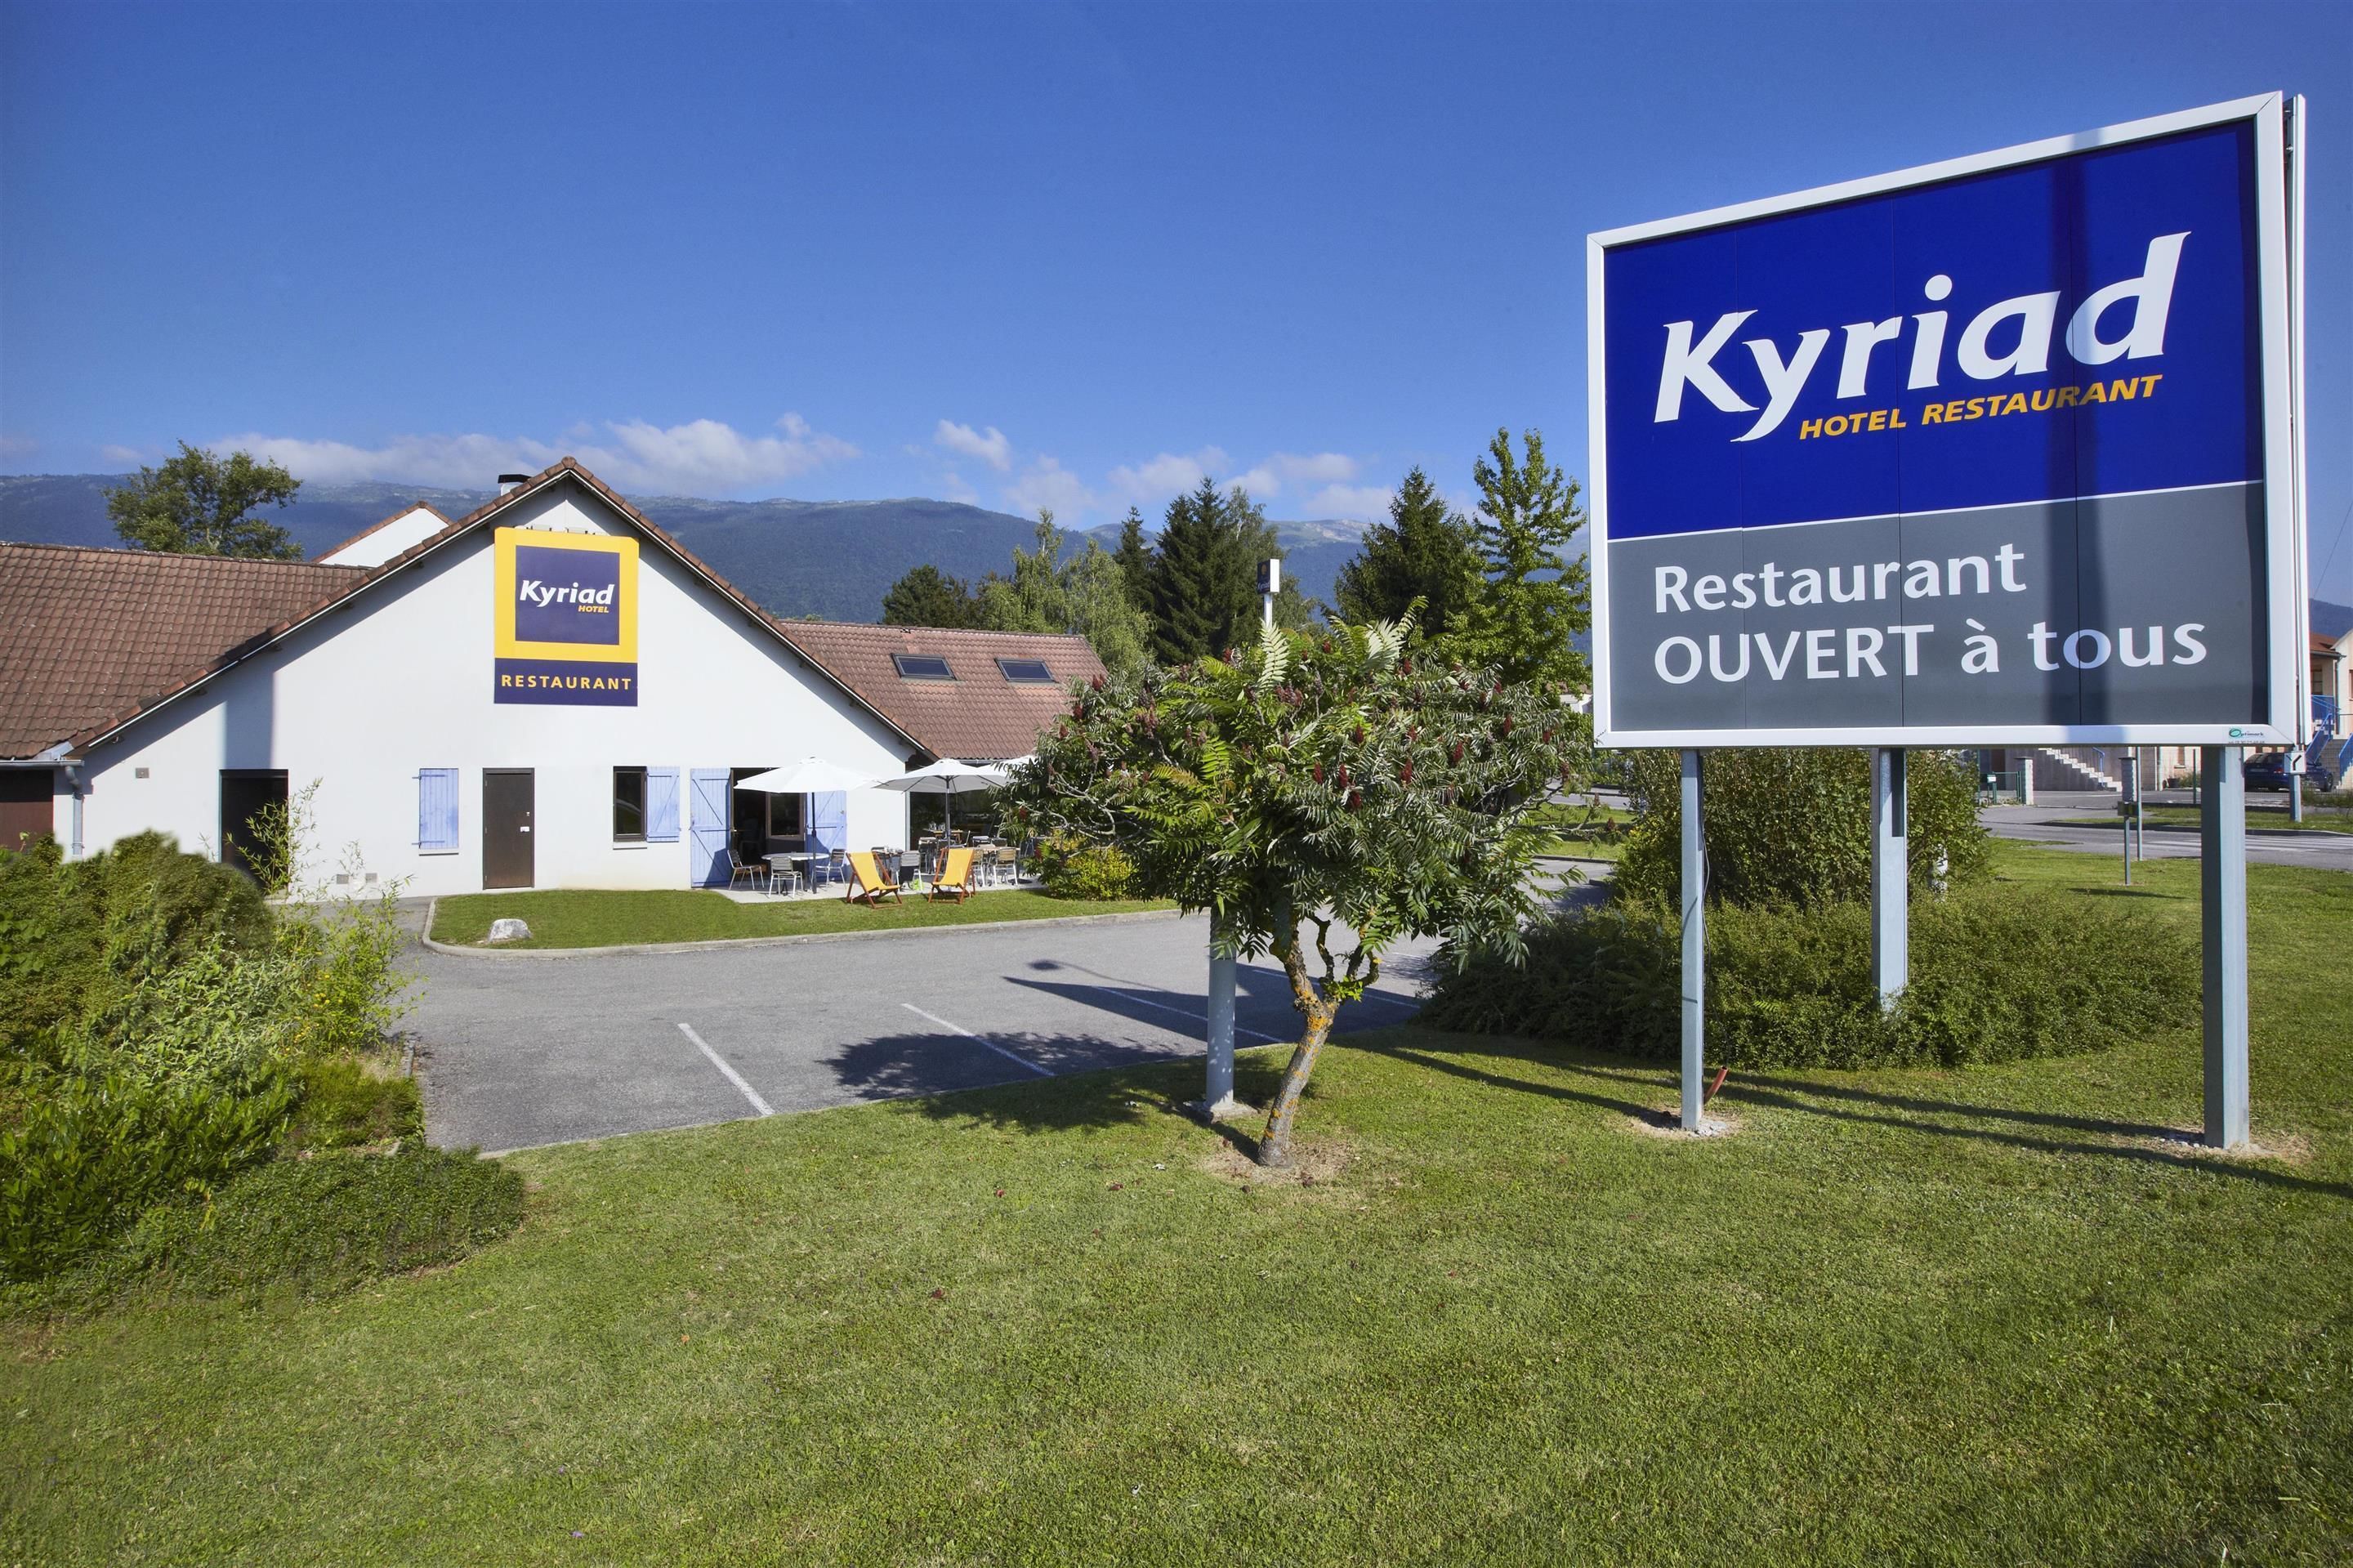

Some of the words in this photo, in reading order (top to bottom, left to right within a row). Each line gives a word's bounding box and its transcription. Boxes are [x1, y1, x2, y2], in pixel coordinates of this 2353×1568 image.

[1654, 230, 2192, 443] Kyriad
[1800, 408, 1907, 440] HOTEL
[1922, 373, 2163, 427] RESTAURANT
[519, 579, 615, 608] Kyriad
[578, 605, 609, 614] HOTEL
[1654, 543, 2027, 614] Restaurant
[501, 674, 632, 690] RESTAURANT
[1654, 623, 1935, 686] OUVERT
[1960, 618, 2001, 675] à
[2026, 621, 2208, 672] tous
